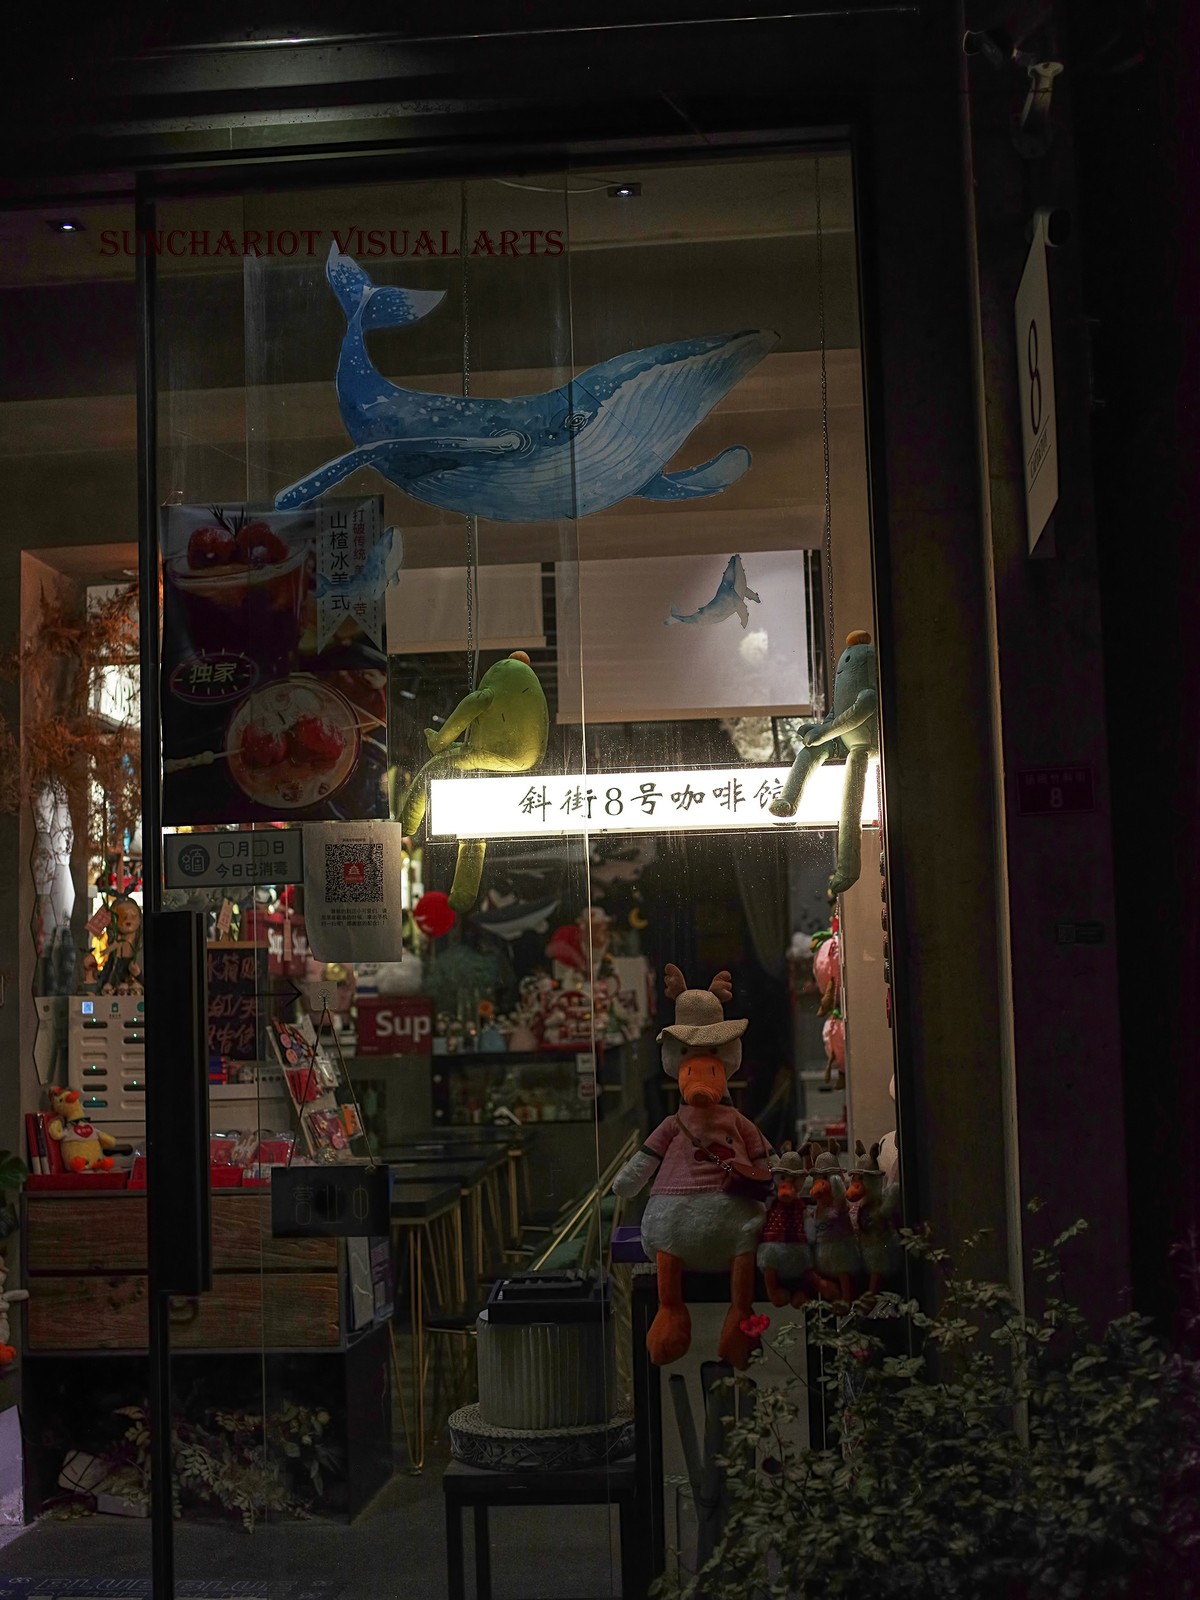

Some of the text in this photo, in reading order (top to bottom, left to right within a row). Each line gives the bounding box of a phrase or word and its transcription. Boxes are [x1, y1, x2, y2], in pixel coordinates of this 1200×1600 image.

[100, 225, 565, 258] SUNCHARIOT VISUAL ARTS
[1028, 319, 1042, 436] 8
[330, 511, 350, 611] 山楂冰美式
[189, 662, 237, 684] 独家
[1049, 787, 1064, 809] 8
[216, 861, 288, 878] 今日已消毒
[375, 1009, 431, 1043] Sup
[292, 1184, 369, 1226] 营业中
